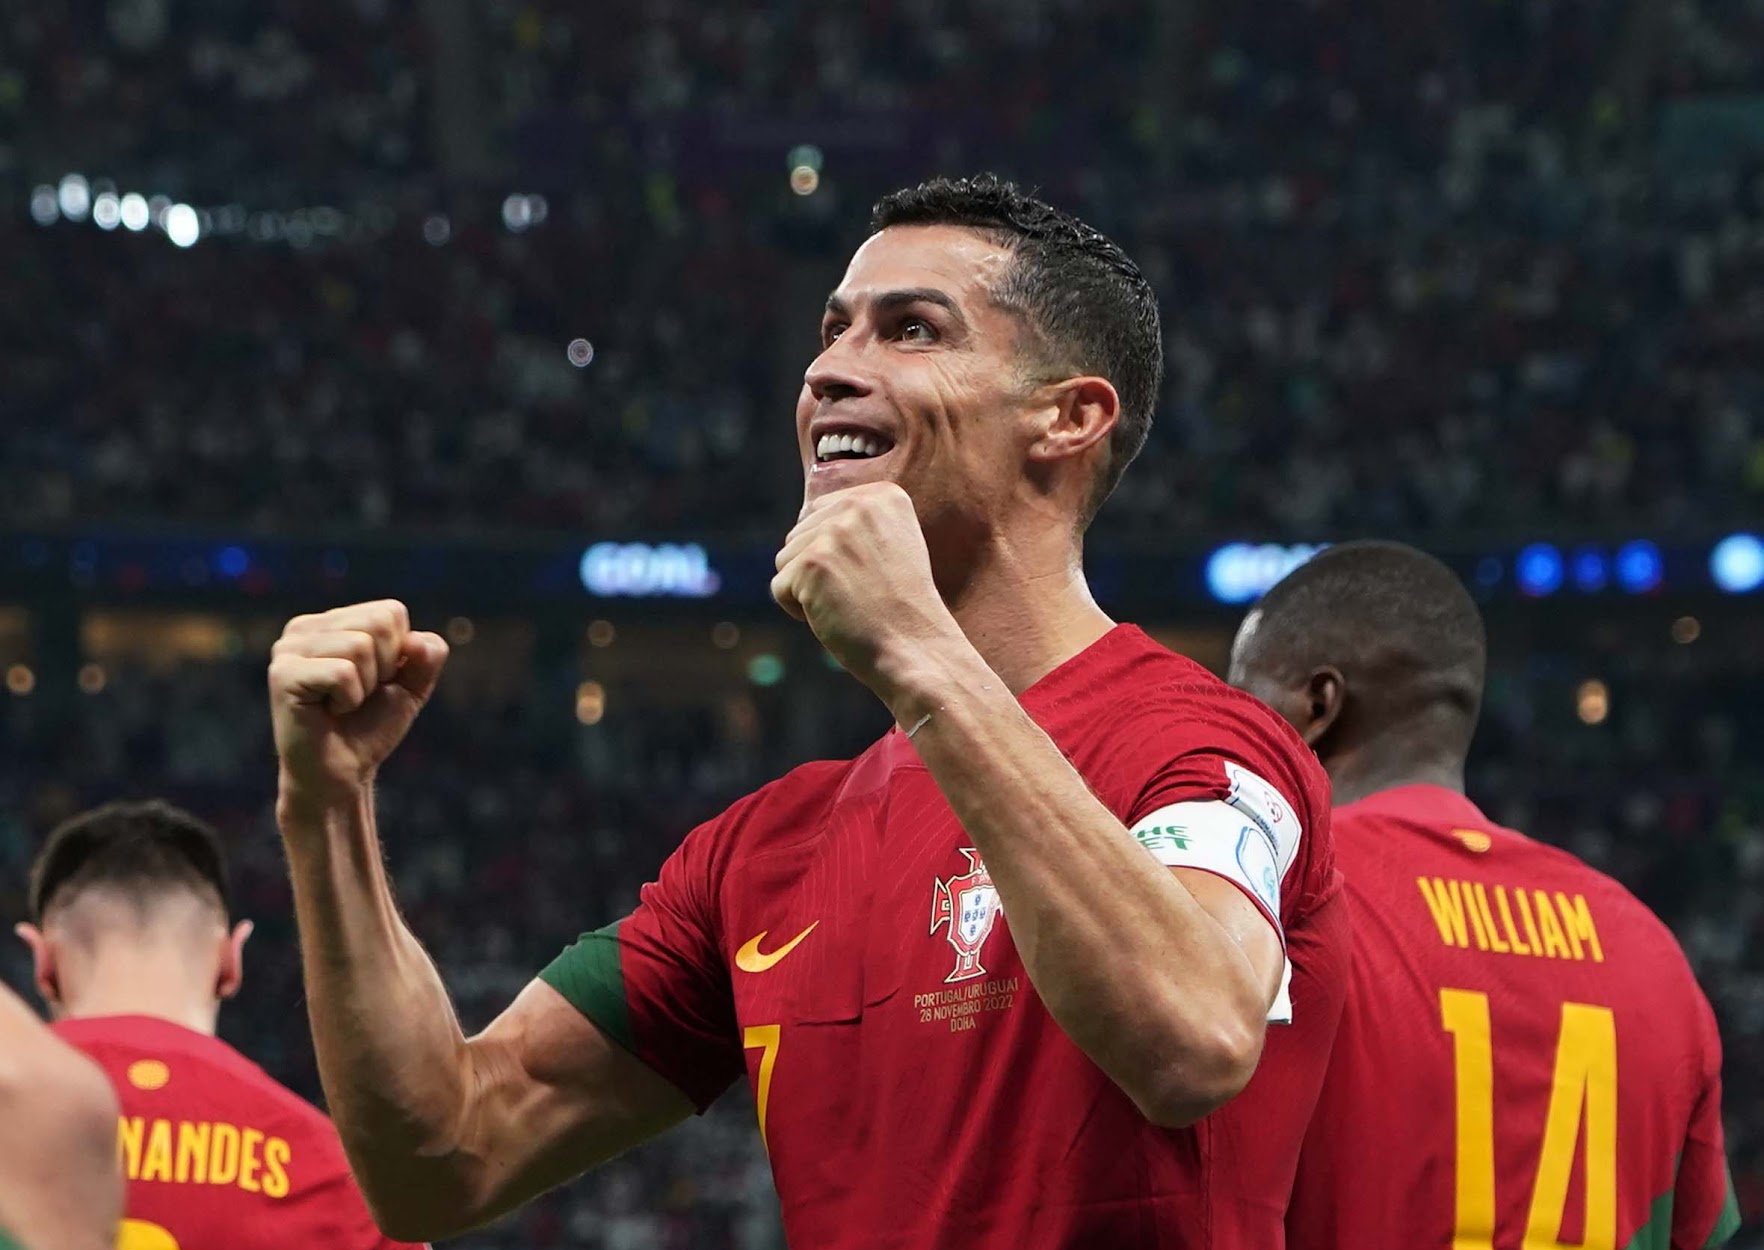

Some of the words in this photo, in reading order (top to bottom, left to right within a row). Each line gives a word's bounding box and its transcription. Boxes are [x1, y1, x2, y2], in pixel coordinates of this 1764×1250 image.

[580, 541, 721, 597] GOAL
[1133, 825, 1190, 838] HE
[1417, 876, 1605, 963] WILLIAM
[914, 977, 1019, 1008] PORTUGAL/URUGUAI
[919, 1008, 932, 1023] 28
[933, 999, 981, 1020] NOVEMBRO
[983, 994, 1013, 1011] 2022
[950, 1015, 976, 1033] DOHA
[743, 1024, 781, 1161] 7
[117, 1115, 291, 1198] NANDES
